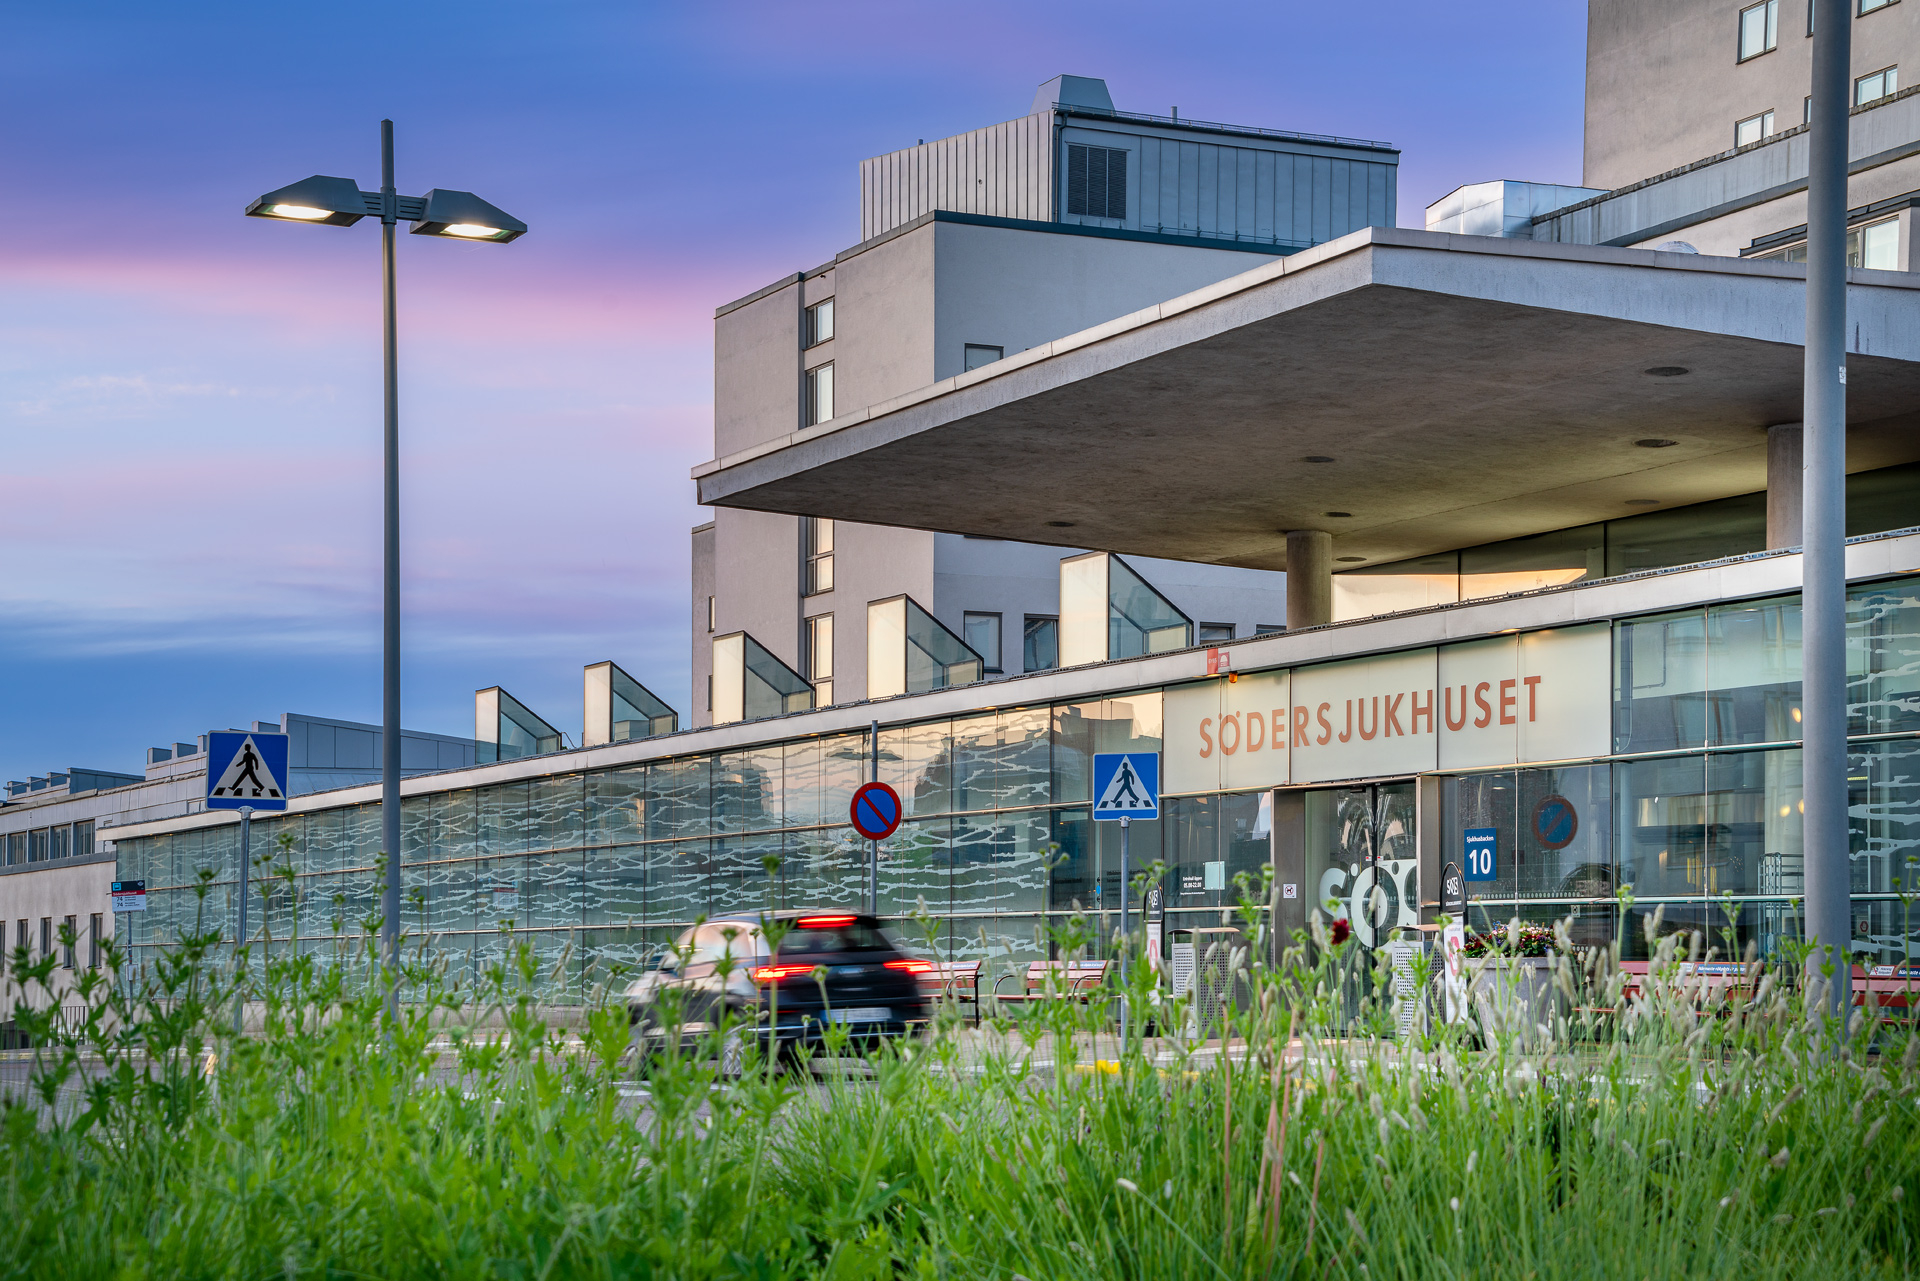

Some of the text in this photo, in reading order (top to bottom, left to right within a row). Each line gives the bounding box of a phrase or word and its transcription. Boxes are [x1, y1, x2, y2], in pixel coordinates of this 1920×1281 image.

[1199, 675, 1542, 759] SÖDERSJUKHUSET
[1466, 835, 1495, 843] Sjukhusbacken
[1469, 848, 1492, 875] 10
